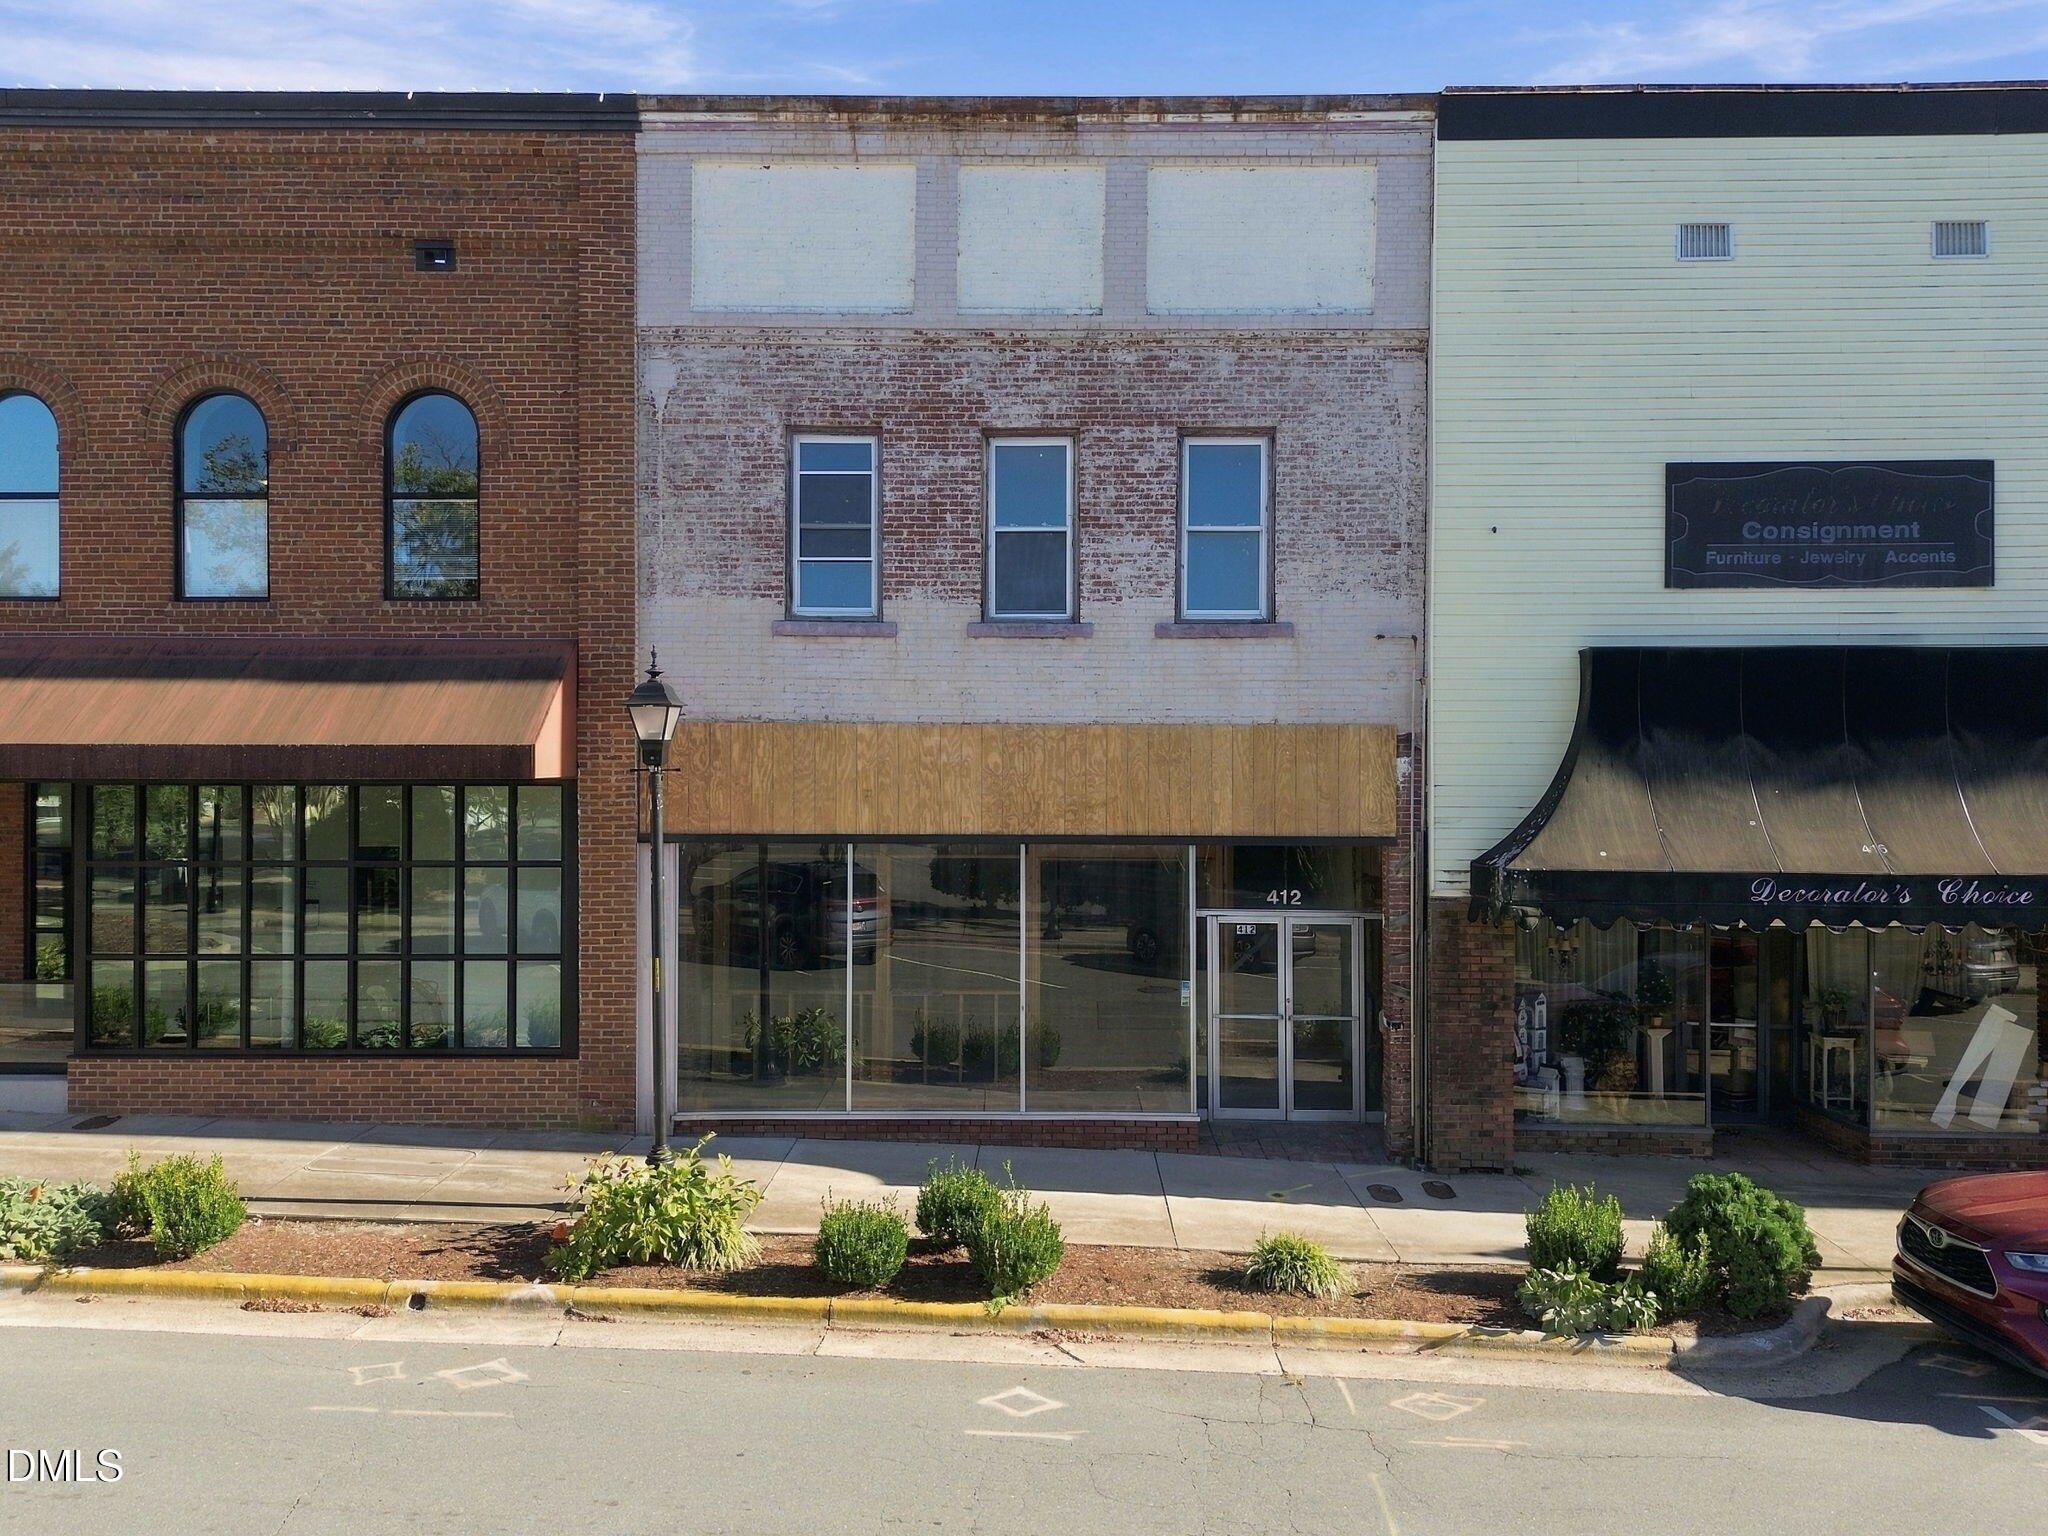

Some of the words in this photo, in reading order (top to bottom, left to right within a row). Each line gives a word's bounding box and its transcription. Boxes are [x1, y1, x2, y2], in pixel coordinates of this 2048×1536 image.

[1742, 521, 1921, 544] Consignment
[1705, 551, 1782, 565] Furniture
[1800, 550, 1866, 566] Jewelry
[1884, 550, 1956, 564] Accents
[1266, 889, 1302, 905] 412
[1750, 877, 1912, 904] Decorator's
[1937, 878, 2035, 905] Choice
[1237, 925, 1255, 934] 412
